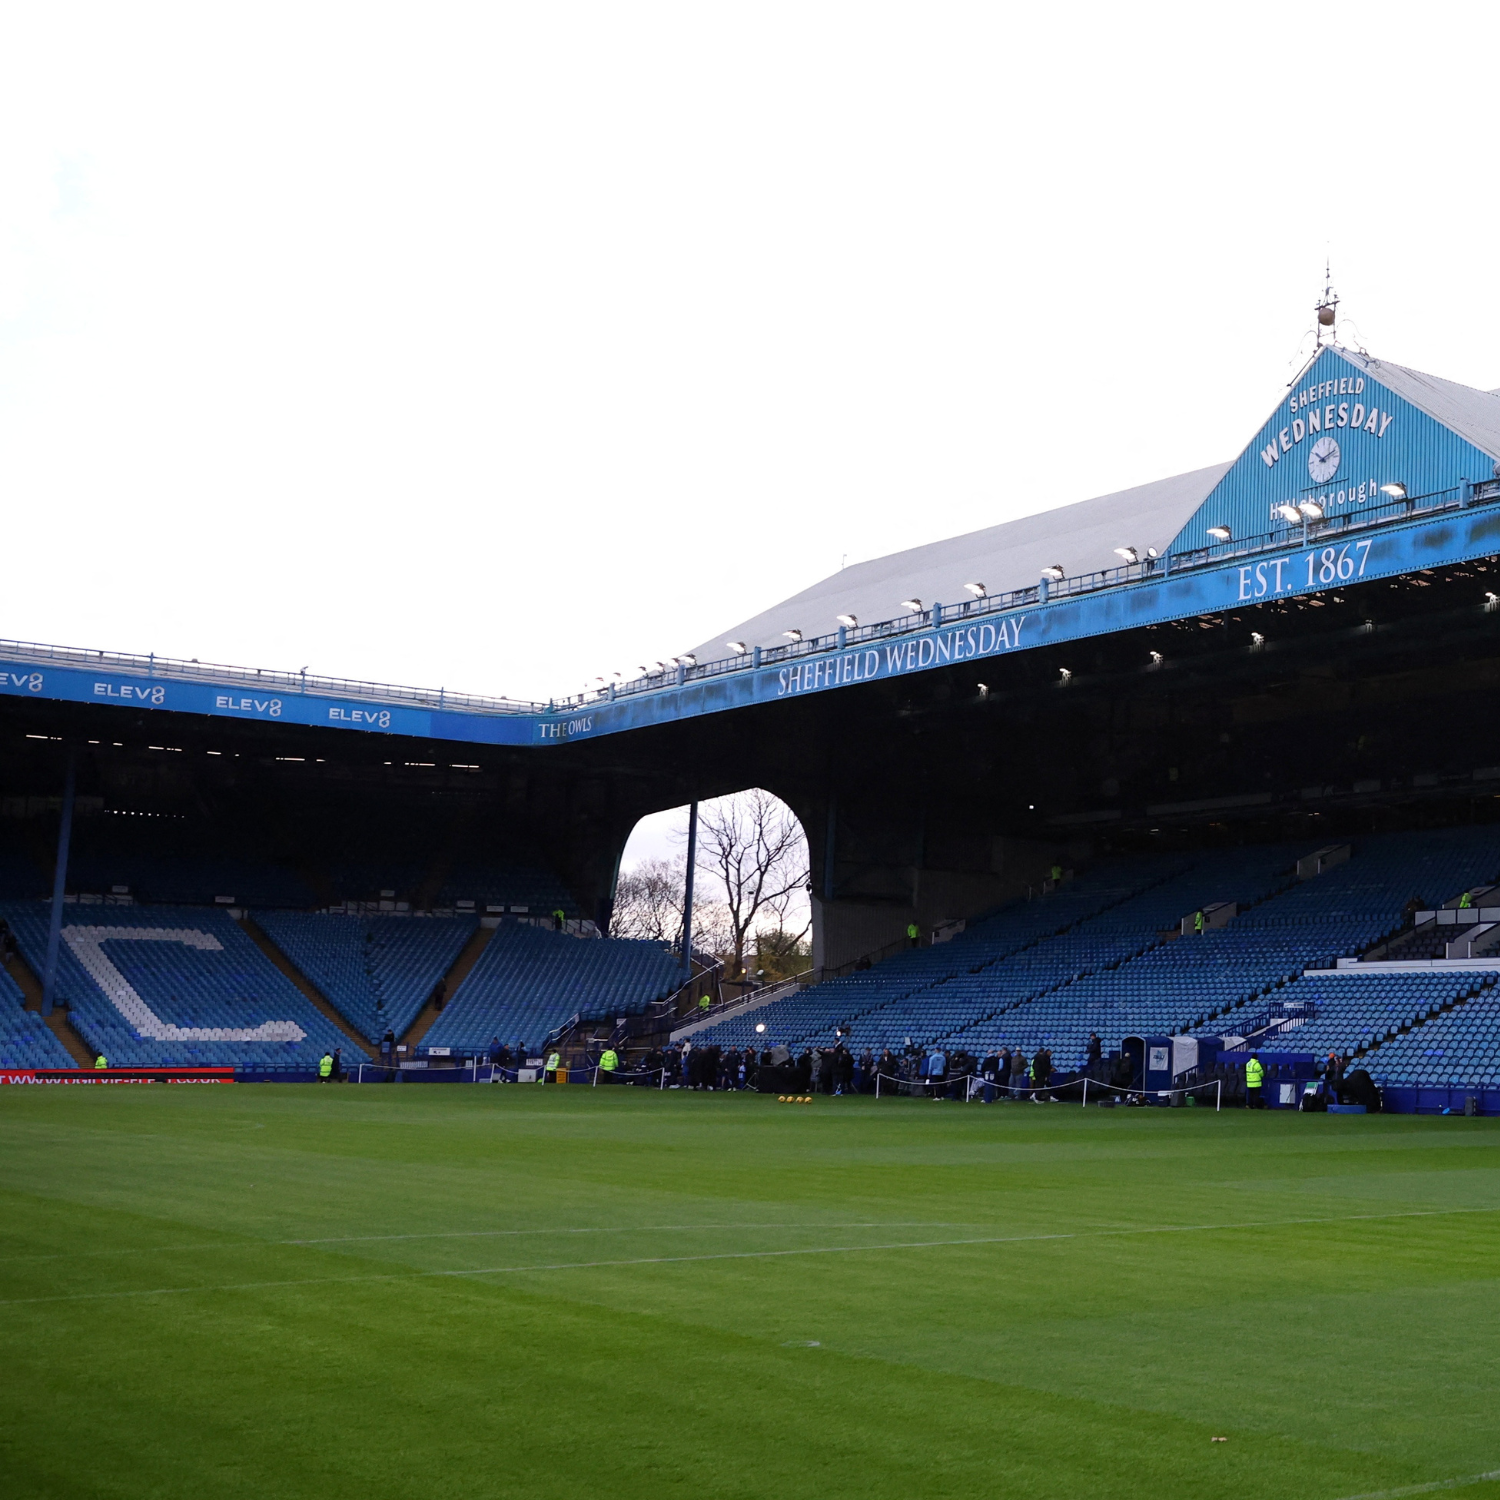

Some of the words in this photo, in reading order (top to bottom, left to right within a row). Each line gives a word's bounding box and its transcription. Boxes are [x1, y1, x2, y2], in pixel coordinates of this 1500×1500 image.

[1289, 377, 1364, 413] SHEFFIELD
[1260, 402, 1393, 468] WEDNESDAY
[1237, 557, 1292, 601] EST.
[1304, 539, 1373, 587] 1867
[777, 650, 880, 696] SHEFFIELD
[885, 616, 1026, 673] WEDNESDAY
[93, 683, 165, 705] ELEV8
[215, 696, 282, 717] ELEV8
[328, 708, 391, 728] ELEV8
[538, 721, 567, 738] THE
[567, 716, 592, 736] OWLS
